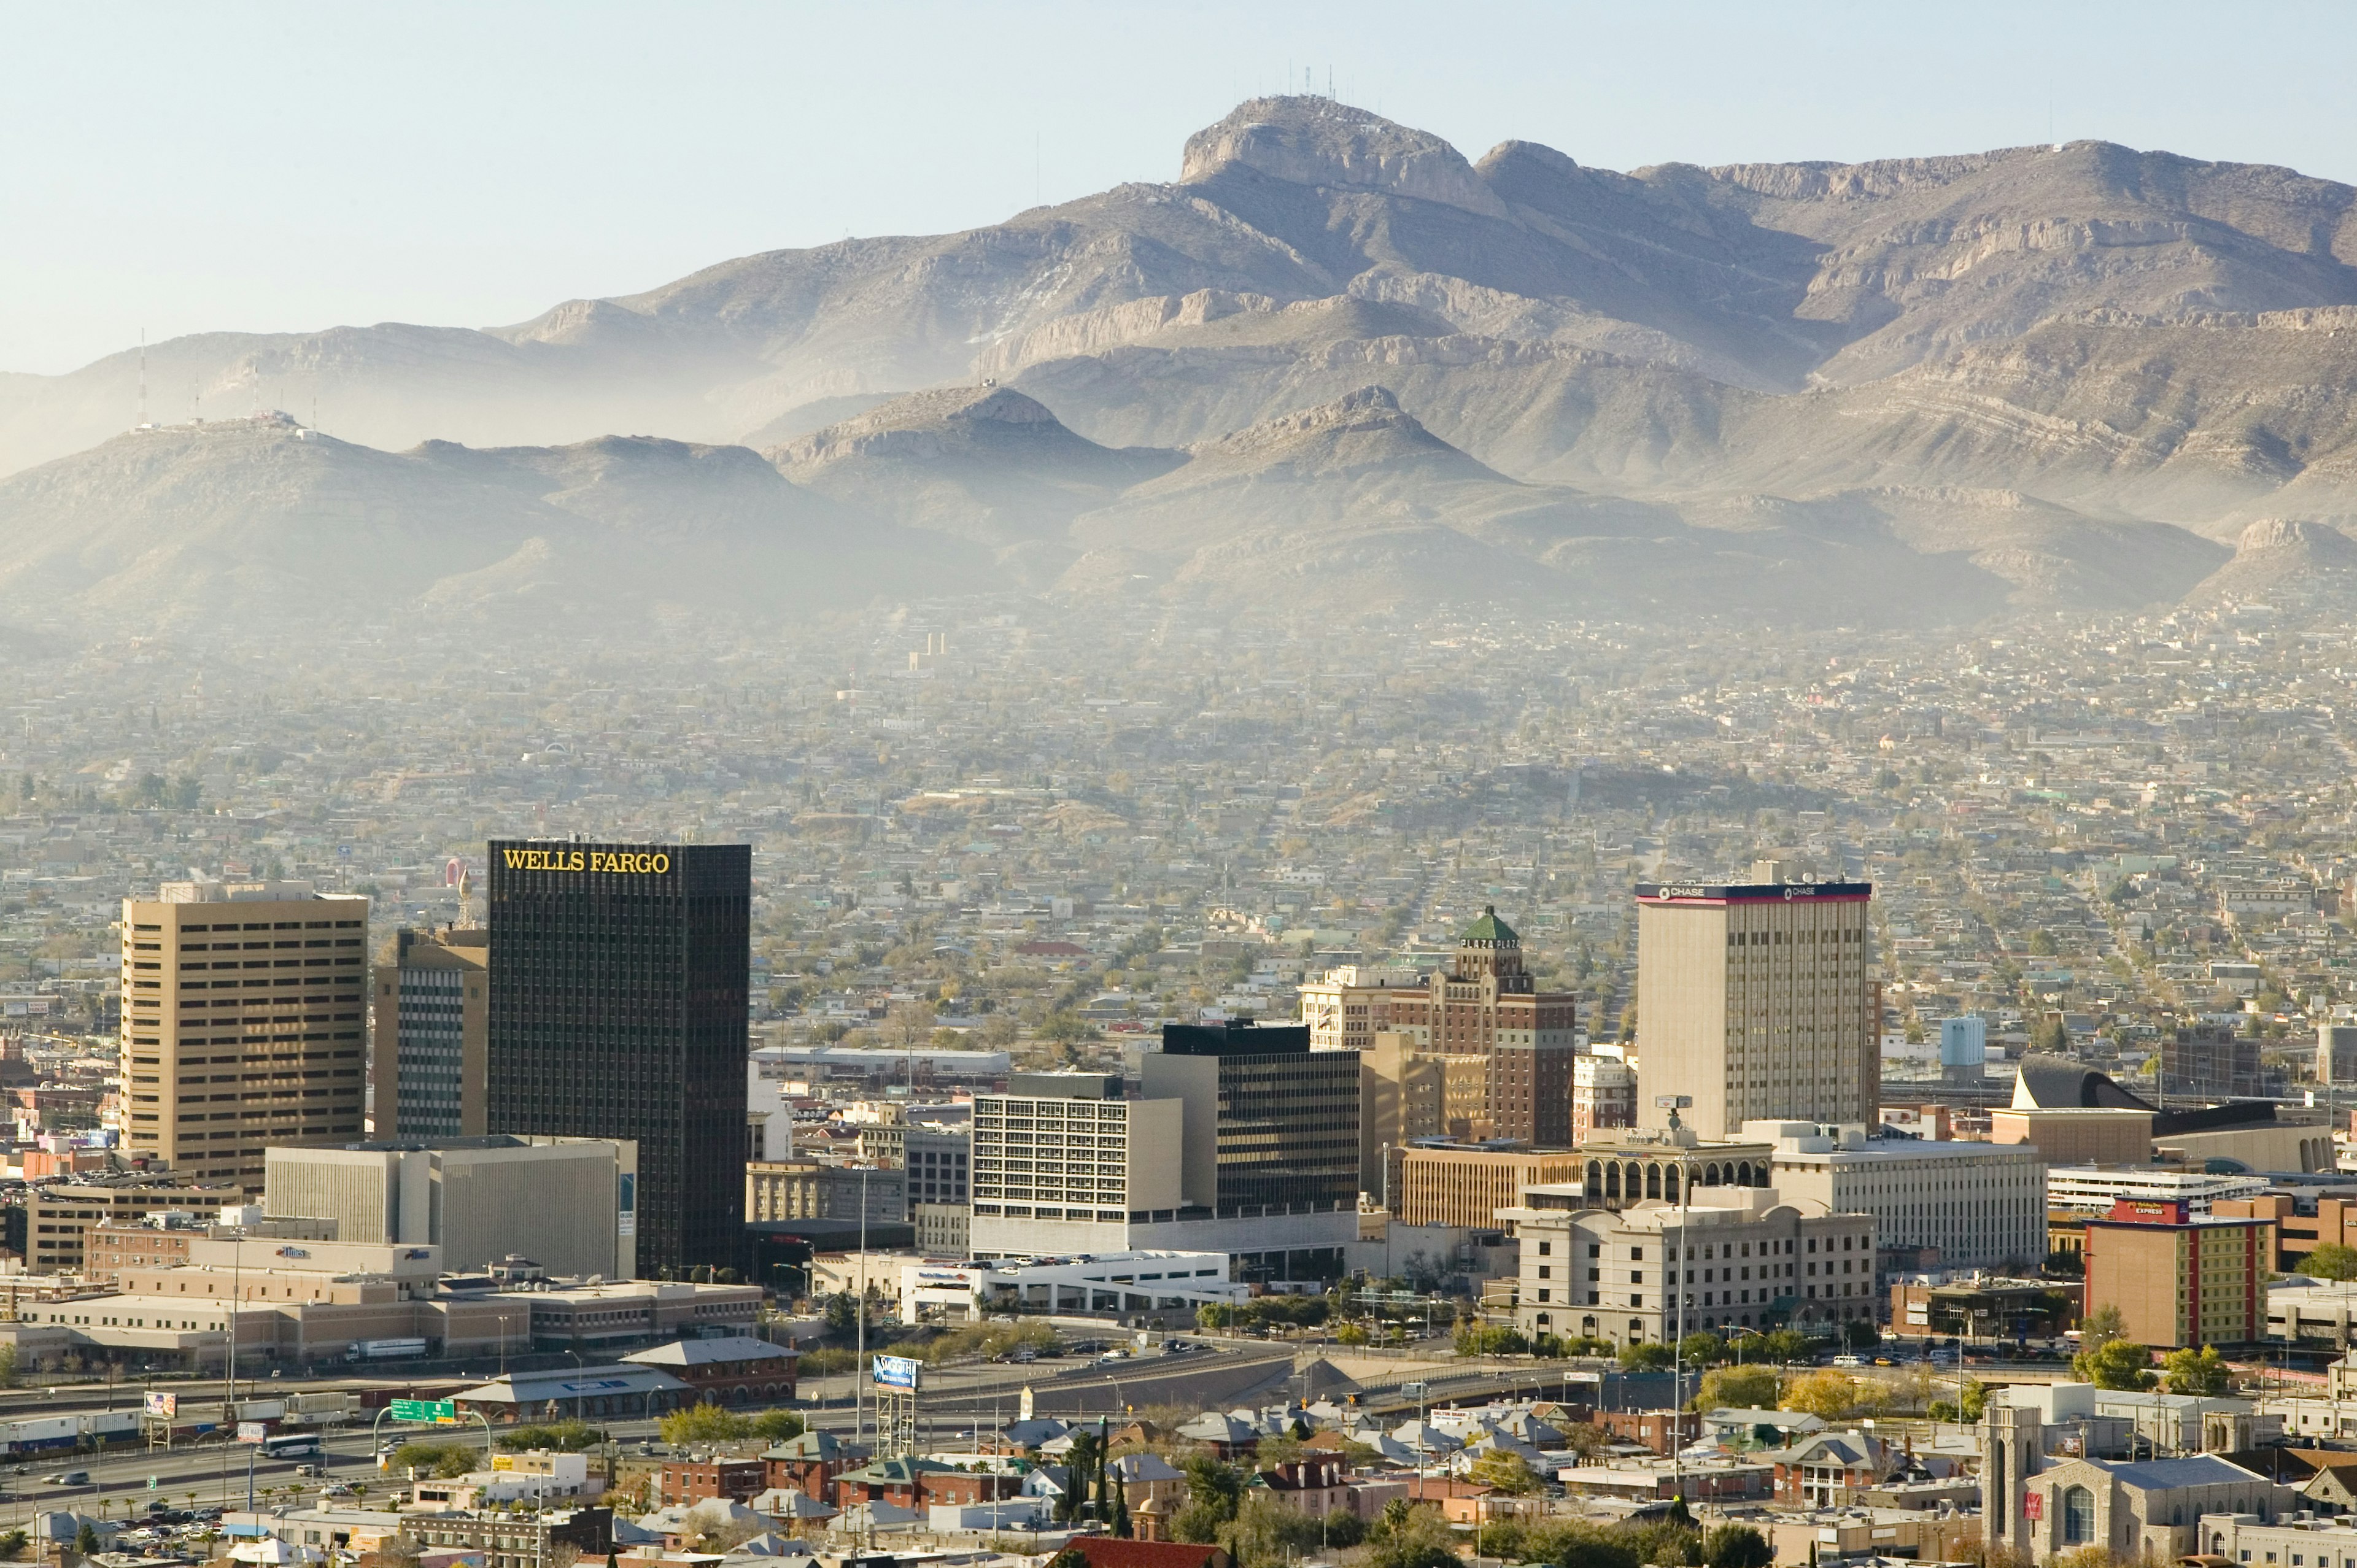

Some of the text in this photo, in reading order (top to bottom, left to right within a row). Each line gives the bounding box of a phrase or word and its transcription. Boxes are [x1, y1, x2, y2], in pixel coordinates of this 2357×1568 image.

[503, 849, 670, 873] WELLS FARGO
[1671, 887, 1705, 896] CHASE
[1460, 939, 1493, 949] PLAZA
[1497, 940, 1521, 949] PLAZA
[282, 1246, 305, 1257] Times
[881, 1357, 912, 1375] SMOOTH
